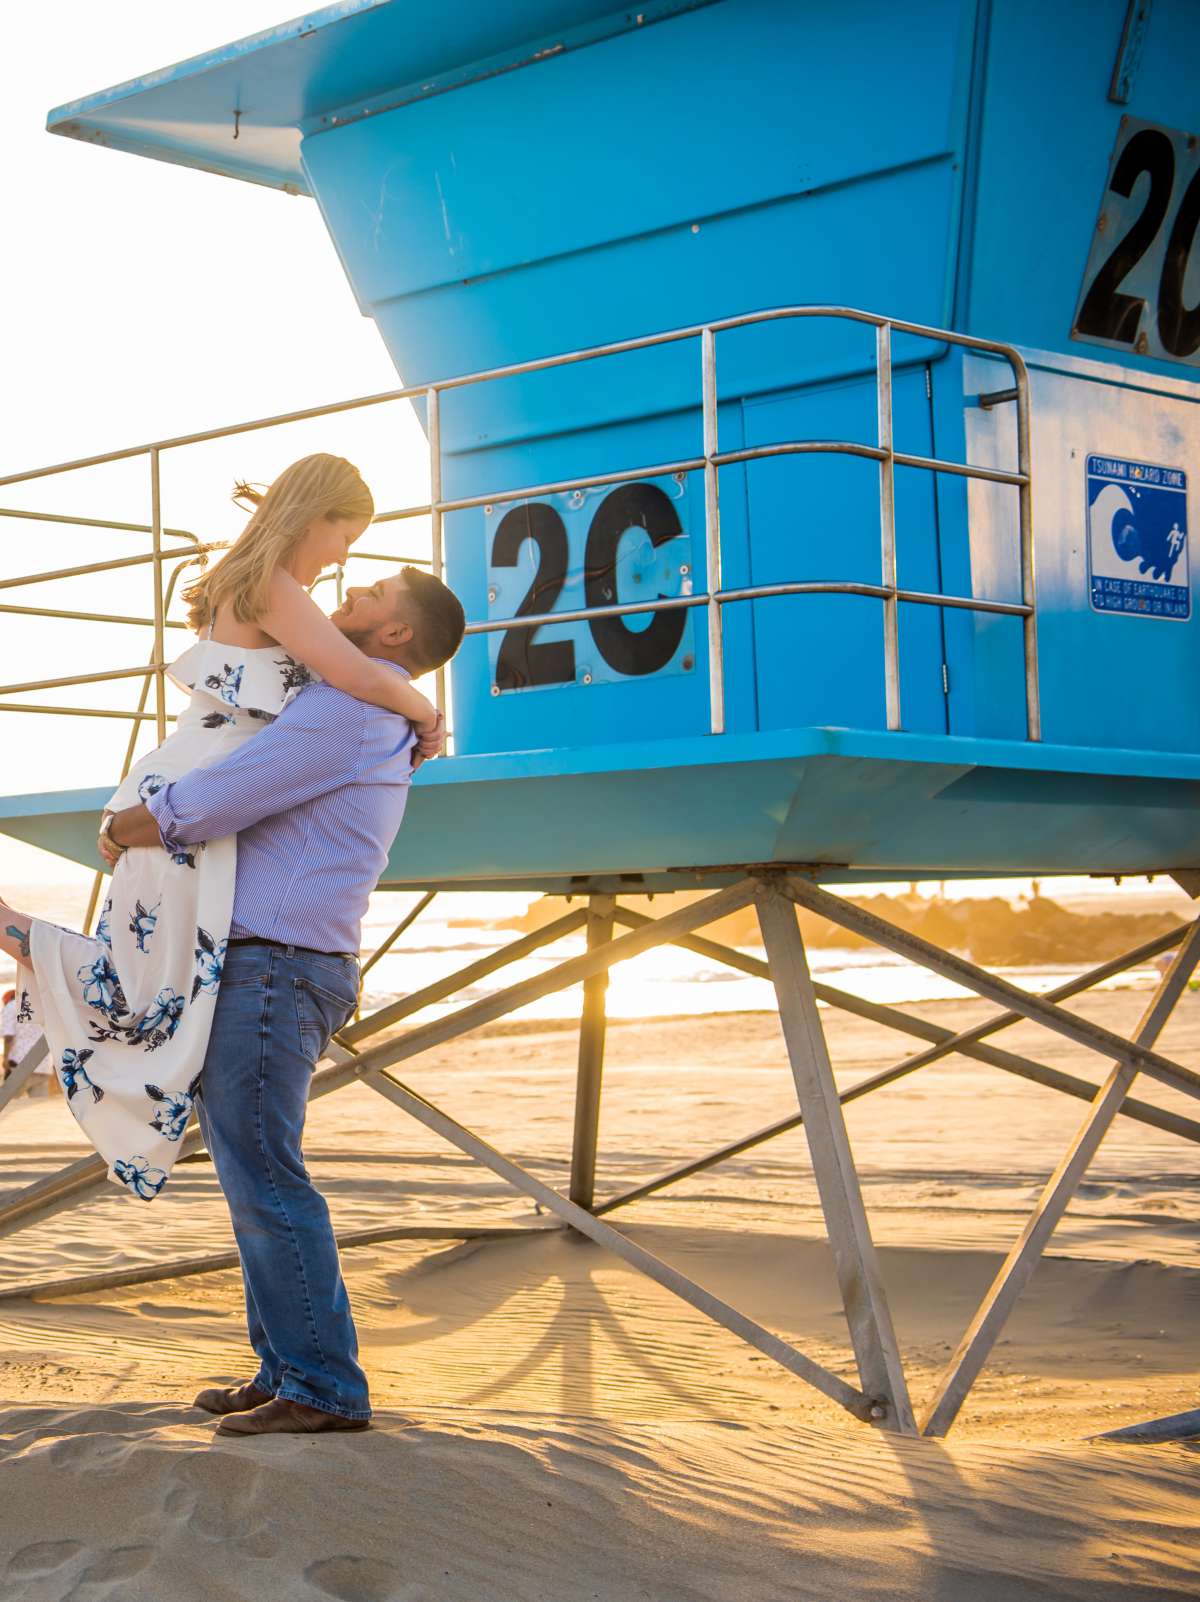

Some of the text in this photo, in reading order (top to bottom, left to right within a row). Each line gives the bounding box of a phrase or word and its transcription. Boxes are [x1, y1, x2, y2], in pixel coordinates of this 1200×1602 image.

[1092, 458, 1183, 487] TSUNAMI HAZARD ZONE
[1104, 580, 1121, 594] CASE
